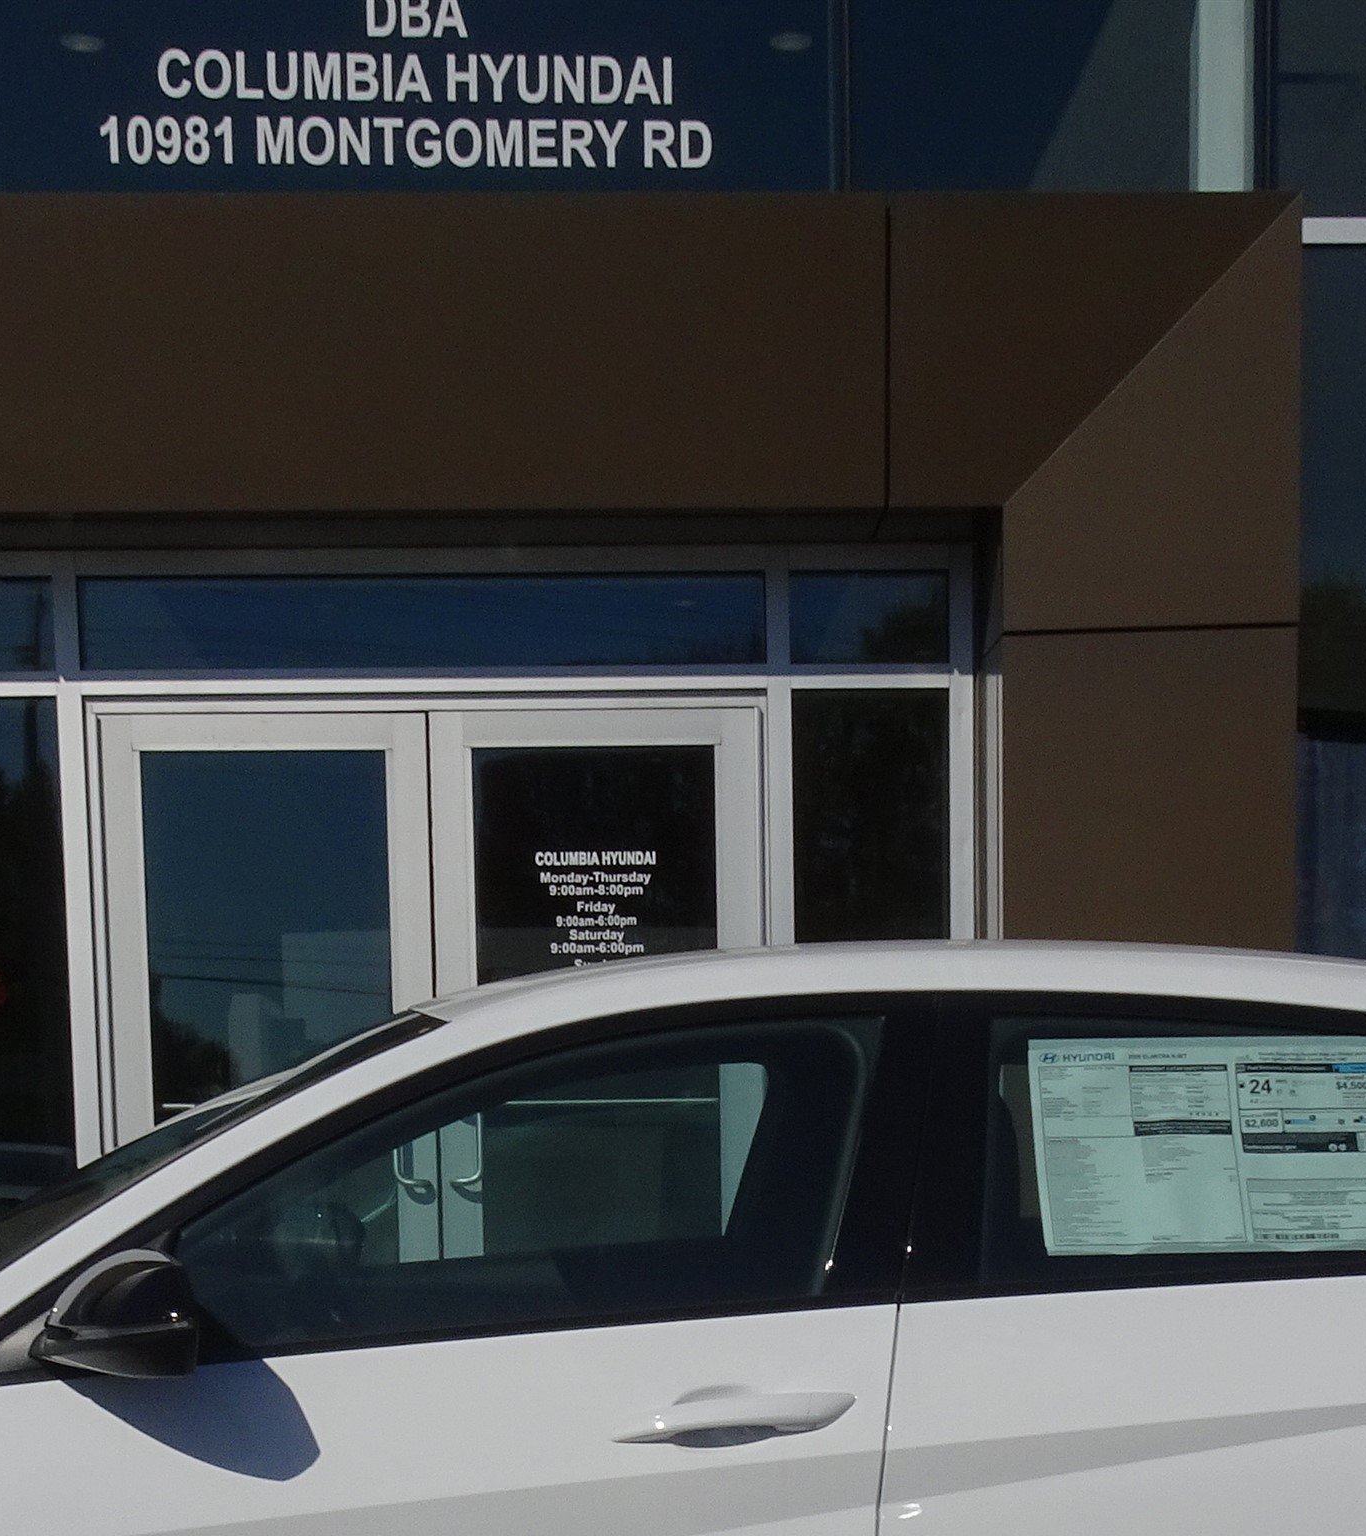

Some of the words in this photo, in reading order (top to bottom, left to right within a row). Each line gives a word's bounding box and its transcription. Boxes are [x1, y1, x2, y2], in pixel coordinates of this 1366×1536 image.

[366, 0, 468, 38] DBA
[157, 48, 433, 102] COLUMBIA
[446, 53, 673, 104] HYUNDAI
[99, 115, 234, 165] 10981
[255, 116, 628, 168] MONTGOMERY
[643, 120, 713, 169] RD
[534, 851, 600, 866] COLUMBIA
[601, 851, 657, 866] HYUNDAI
[539, 871, 652, 885] Monday-Thursday
[548, 885, 644, 897] 9:00am-8:00pm
[576, 901, 616, 914] Friday
[555, 915, 638, 928] 9:00am-6:00pm
[568, 929, 625, 943] Saturday
[550, 942, 645, 956] 9:00am-6:00pm
[1062, 1052, 1115, 1063] HYUNDAI
[1249, 1078, 1272, 1095] 24
